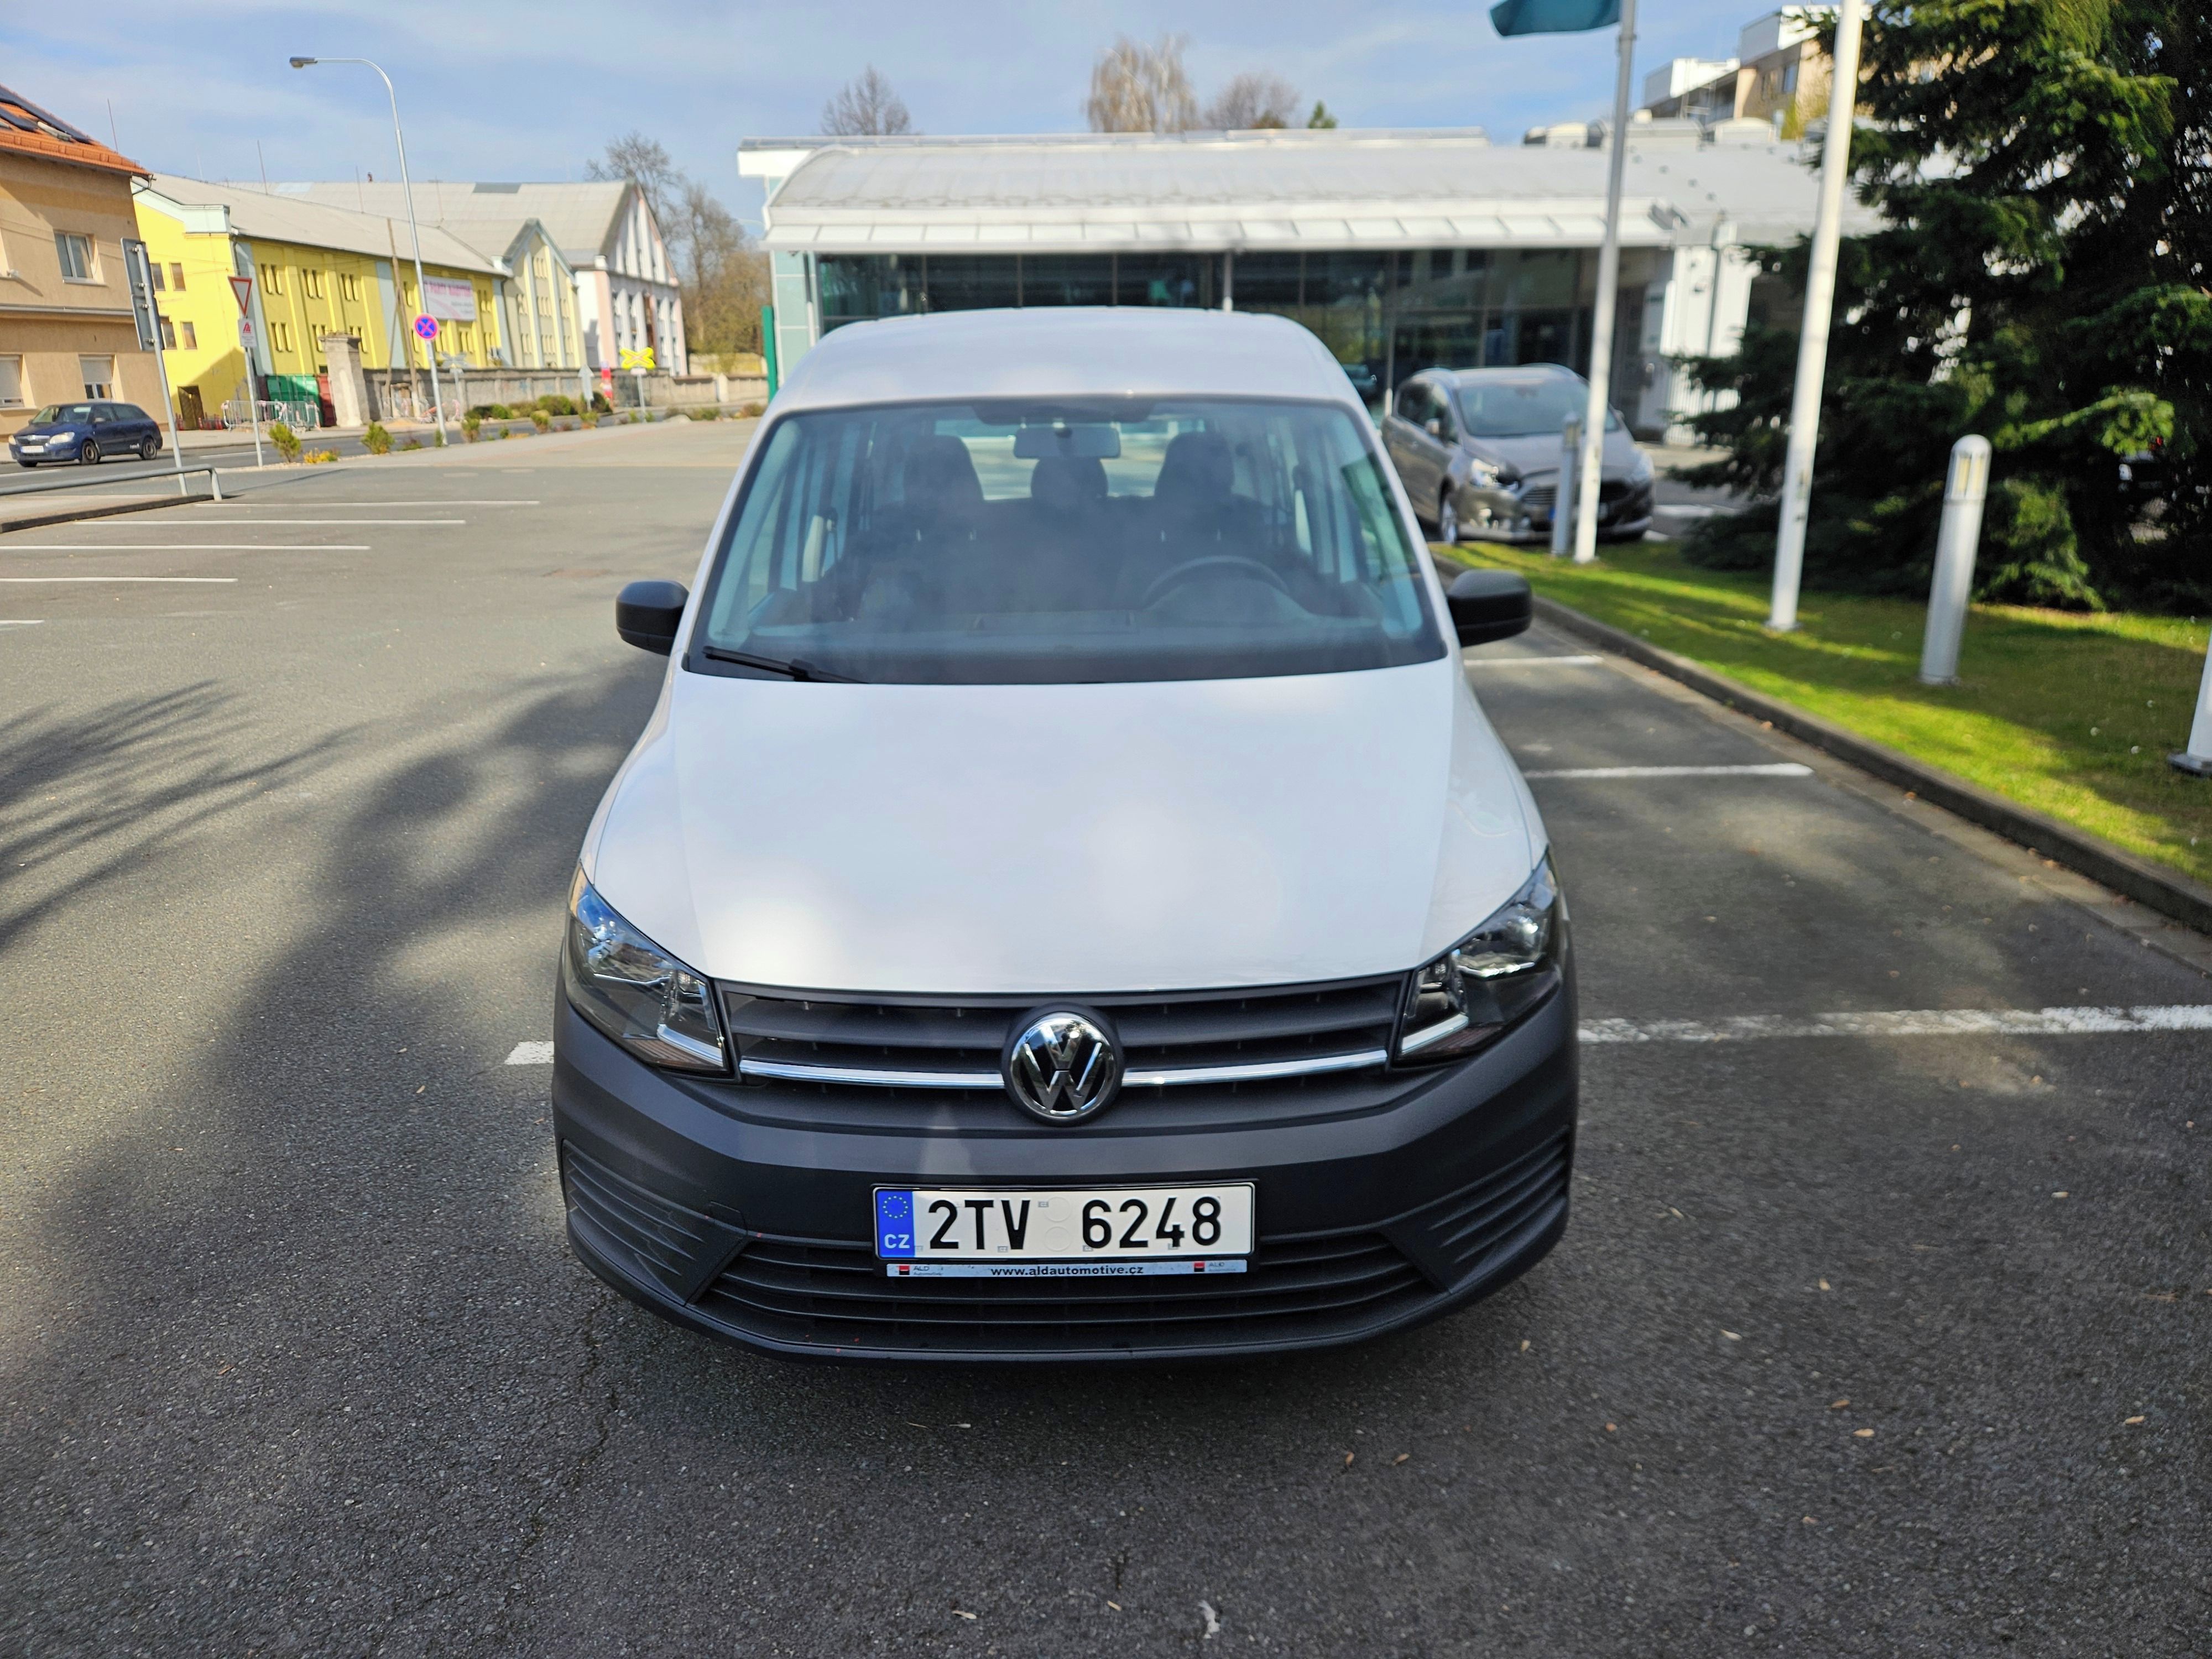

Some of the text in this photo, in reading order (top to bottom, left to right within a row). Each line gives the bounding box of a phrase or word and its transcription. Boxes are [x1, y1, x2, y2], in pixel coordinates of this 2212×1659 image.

[928, 1196, 1221, 1250] 2TV 6248
[884, 1234, 910, 1249] CZ
[990, 1265, 1144, 1276] www.aldautomotive.cz
